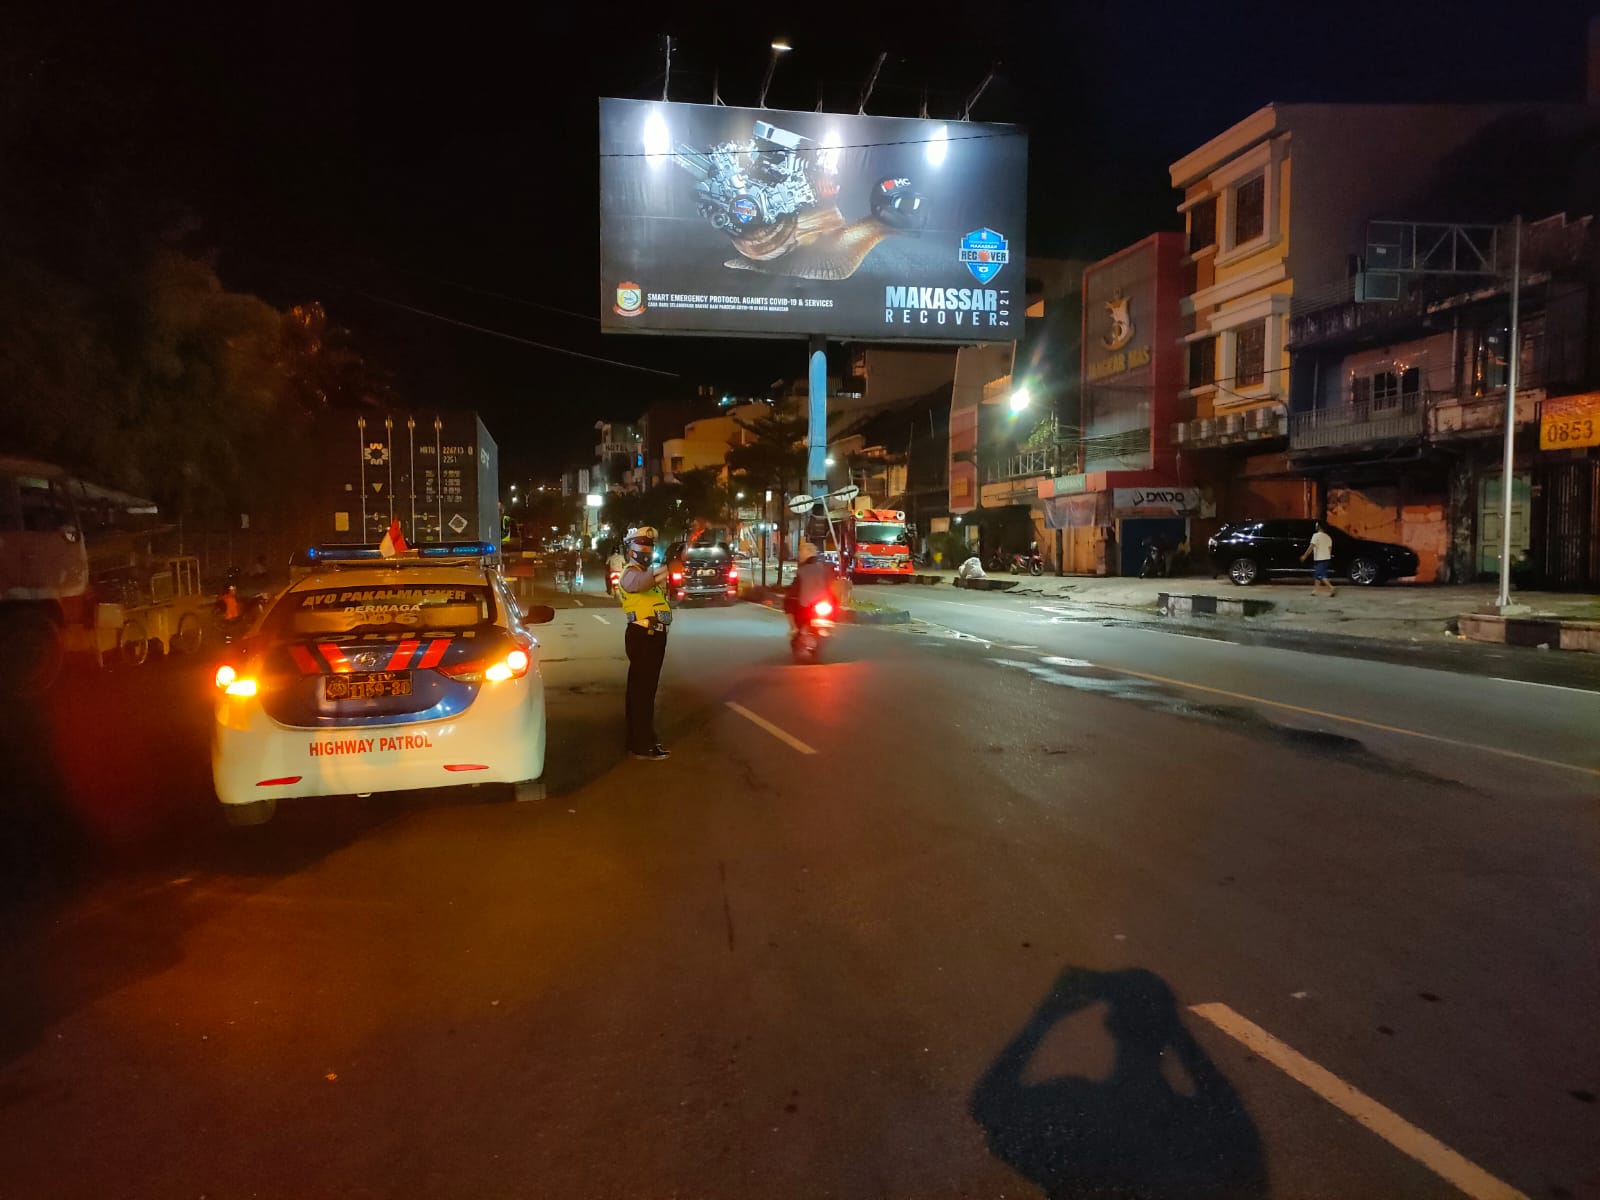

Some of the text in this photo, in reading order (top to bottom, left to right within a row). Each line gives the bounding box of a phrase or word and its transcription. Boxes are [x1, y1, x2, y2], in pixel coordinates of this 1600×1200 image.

[647, 293, 669, 301] SMART
[670, 294, 708, 303] EMERGENCY
[709, 295, 741, 304] PROTOCOL
[769, 297, 798, 306] COVID-19
[798, 298, 804, 306] &
[804, 299, 834, 308] SERVICES
[885, 286, 998, 311] MAKASSAR
[1000, 289, 1009, 326] 2021
[885, 308, 998, 326] RECOVER
[1546, 420, 1593, 442] 0853
[302, 593, 337, 606] AYO
[341, 590, 394, 603] PAKAI
[309, 735, 433, 757] HIGHWAY PATROL
